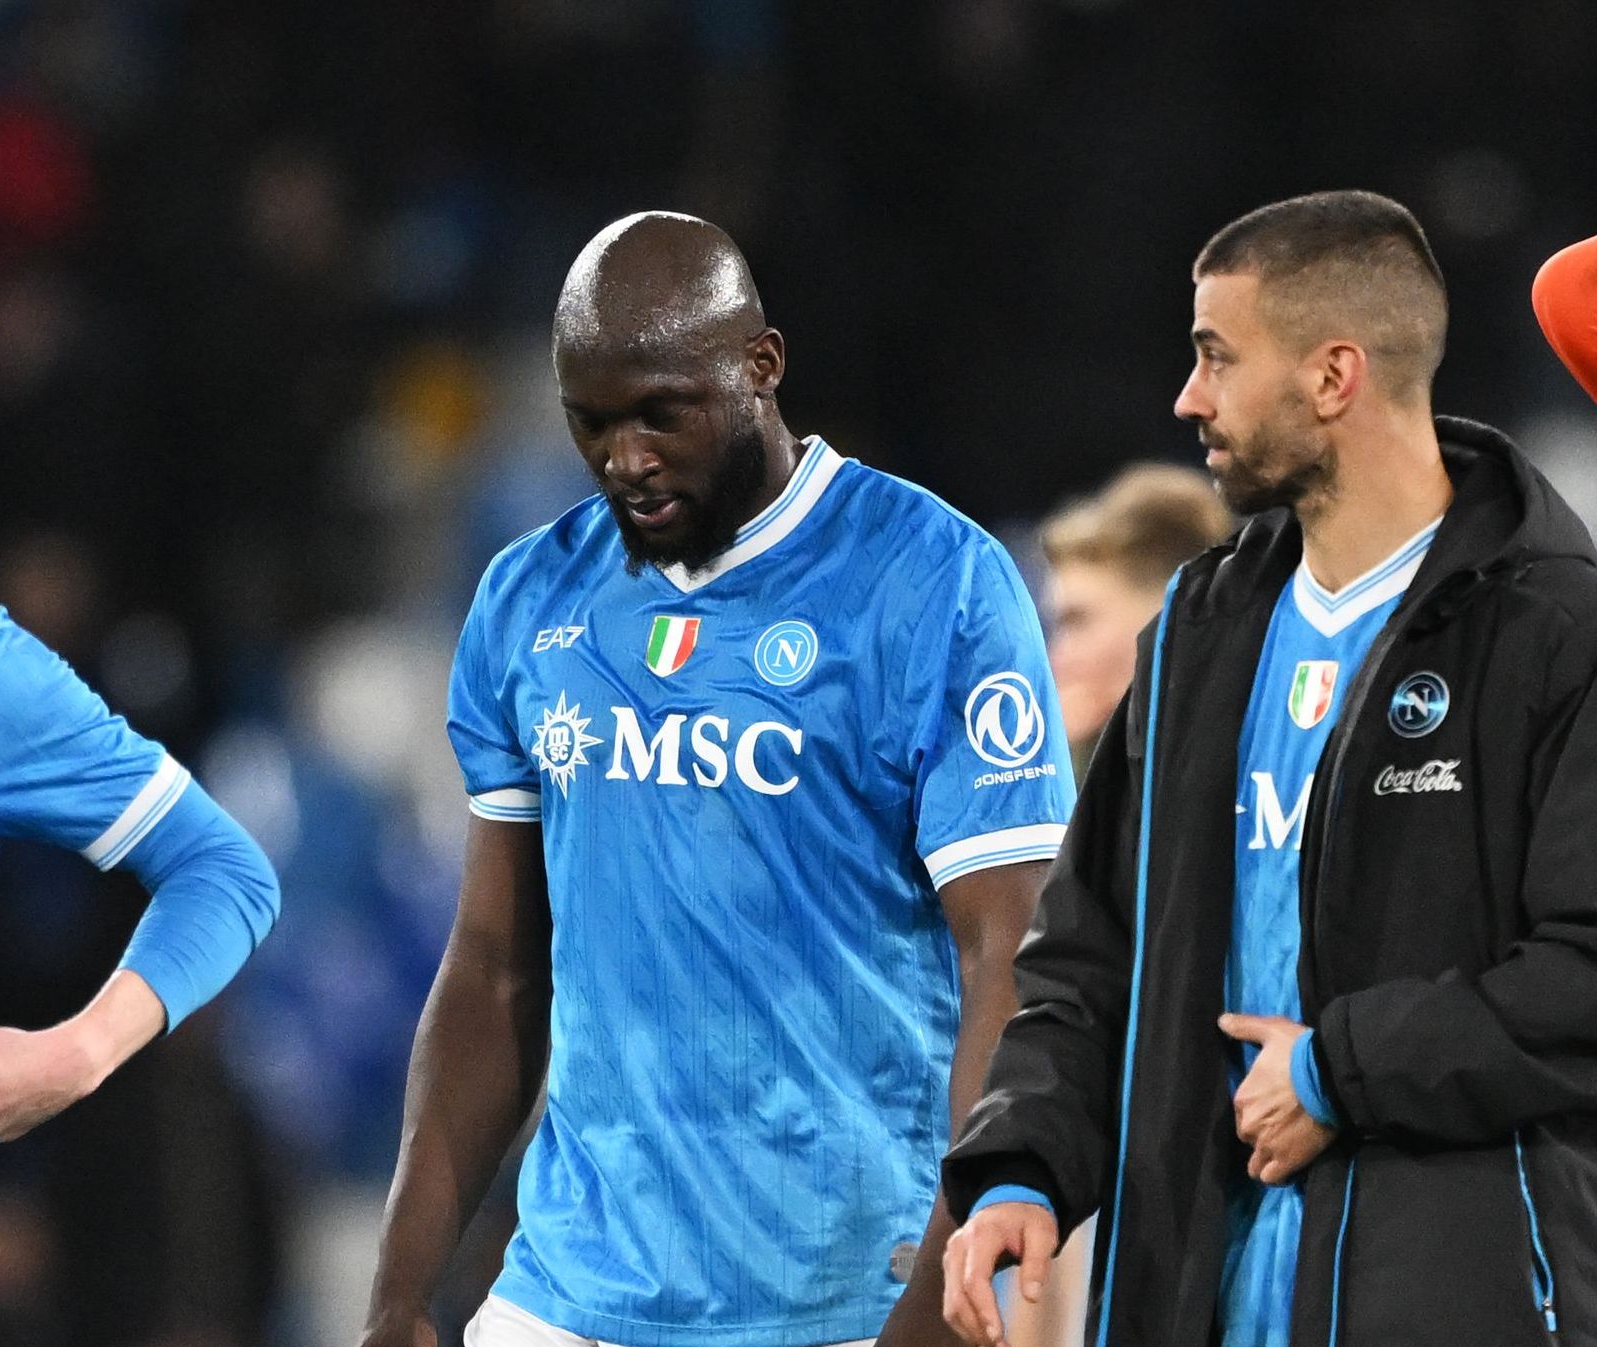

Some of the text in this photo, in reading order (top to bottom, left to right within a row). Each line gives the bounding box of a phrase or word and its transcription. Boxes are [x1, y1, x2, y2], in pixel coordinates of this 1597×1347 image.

[533, 625, 585, 653] EA7
[772, 640, 804, 668] N
[1405, 688, 1430, 720] N
[605, 706, 802, 795] MSC
